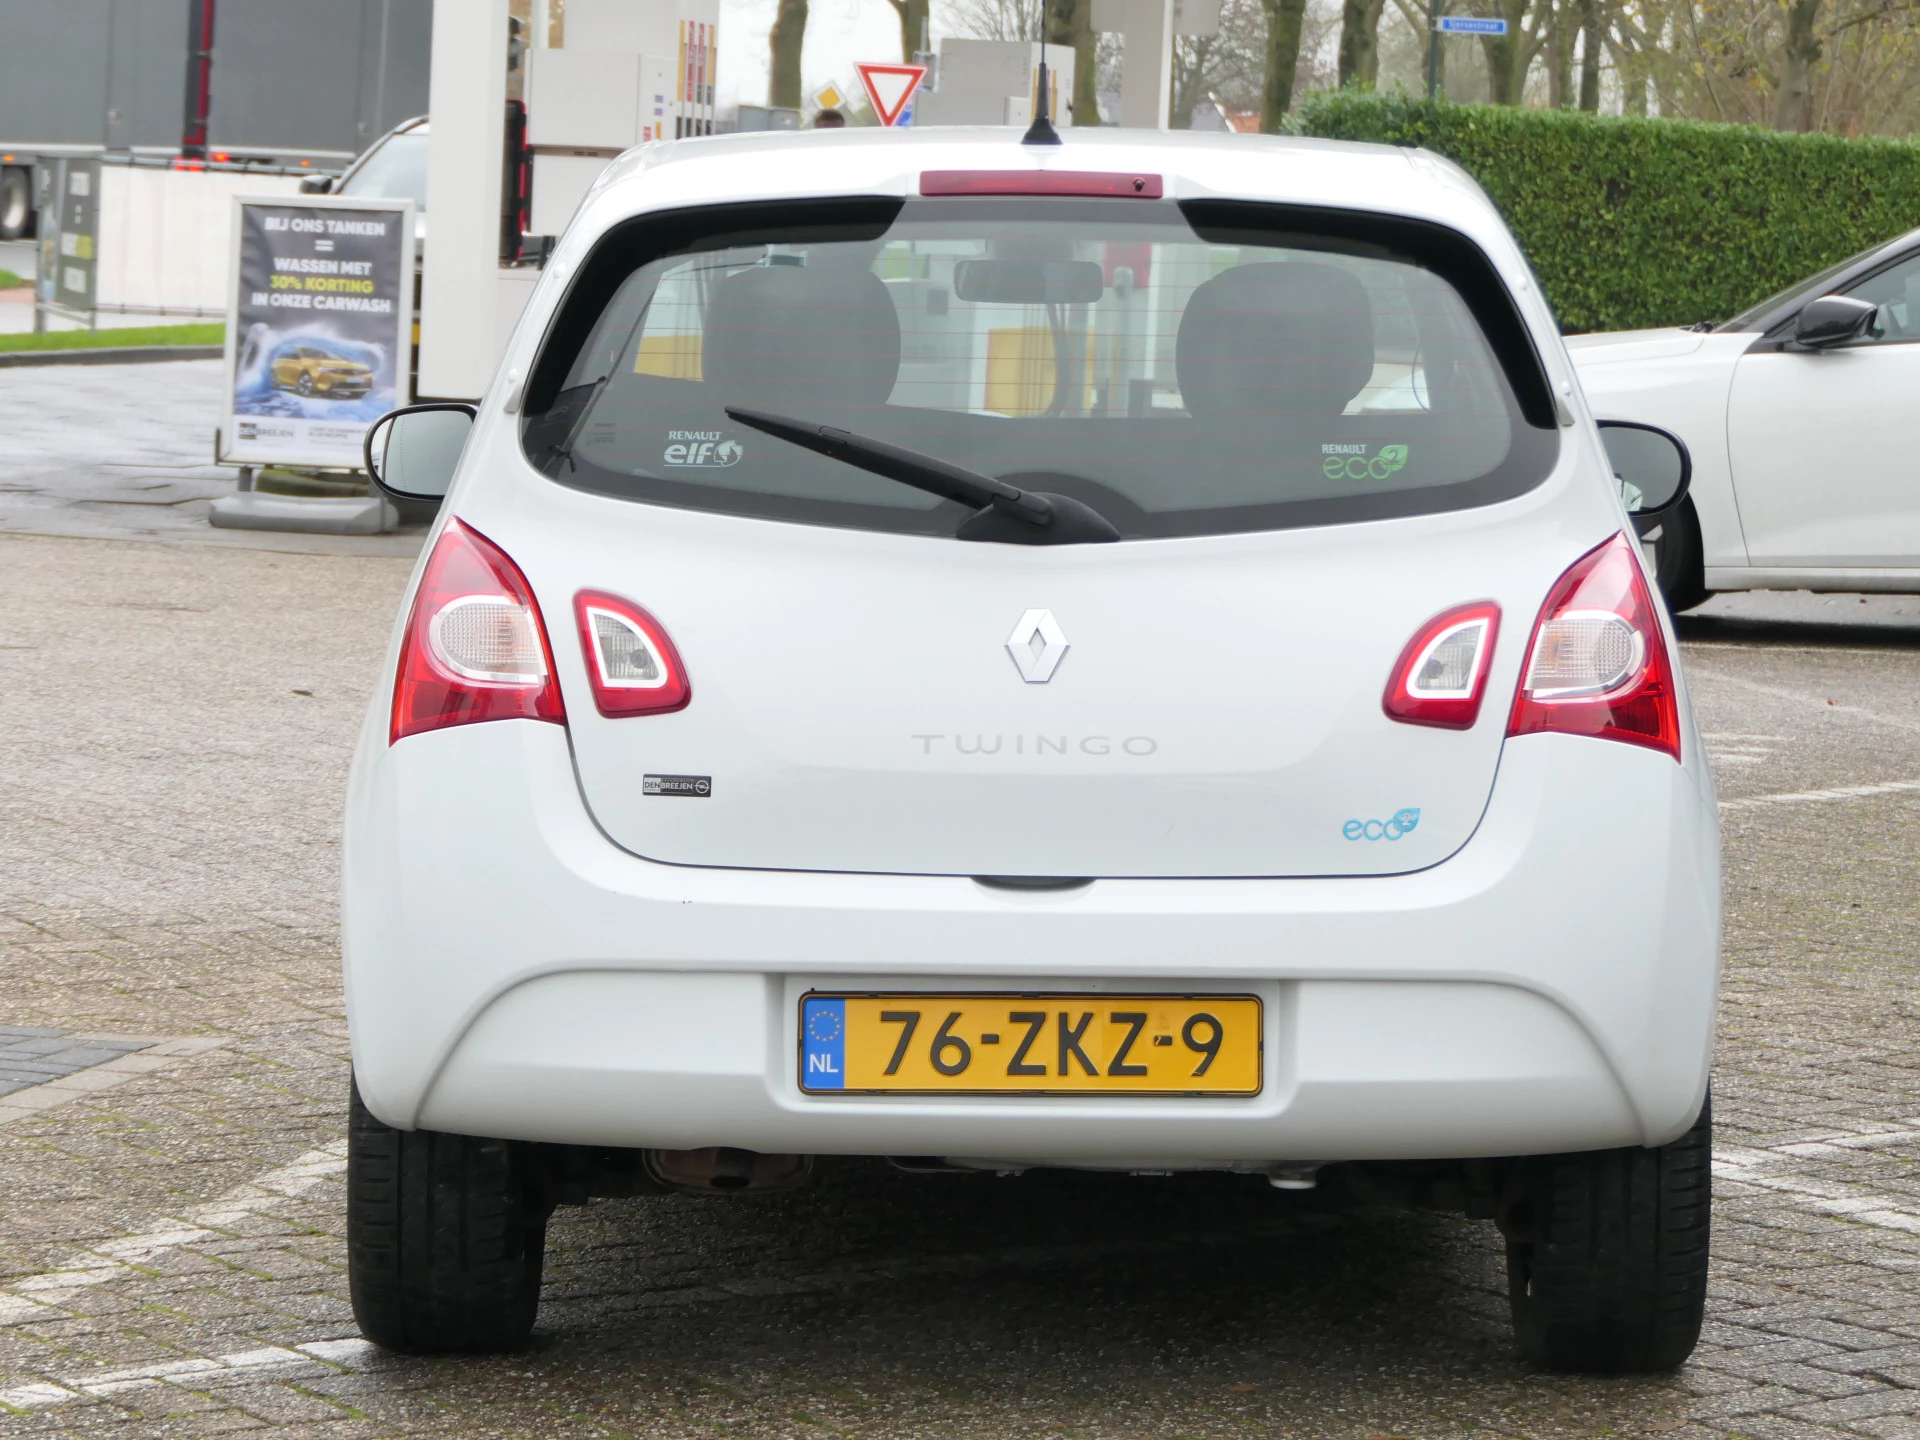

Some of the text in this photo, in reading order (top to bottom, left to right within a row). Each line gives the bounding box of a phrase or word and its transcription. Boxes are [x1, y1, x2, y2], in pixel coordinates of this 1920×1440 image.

[264, 216, 386, 236] BIJ ONS TANKEN
[273, 257, 373, 276] WASSEN MET
[270, 275, 374, 294] 30% KORTING
[252, 292, 391, 313] IN ONZE CARWASH
[668, 430, 722, 441] RENAULT
[663, 442, 715, 465] elf
[1322, 443, 1367, 455] RENAULT
[910, 734, 1158, 757] TWINGO
[879, 1010, 1224, 1077] 76-ZKZ-9
[809, 1053, 839, 1073] NL
